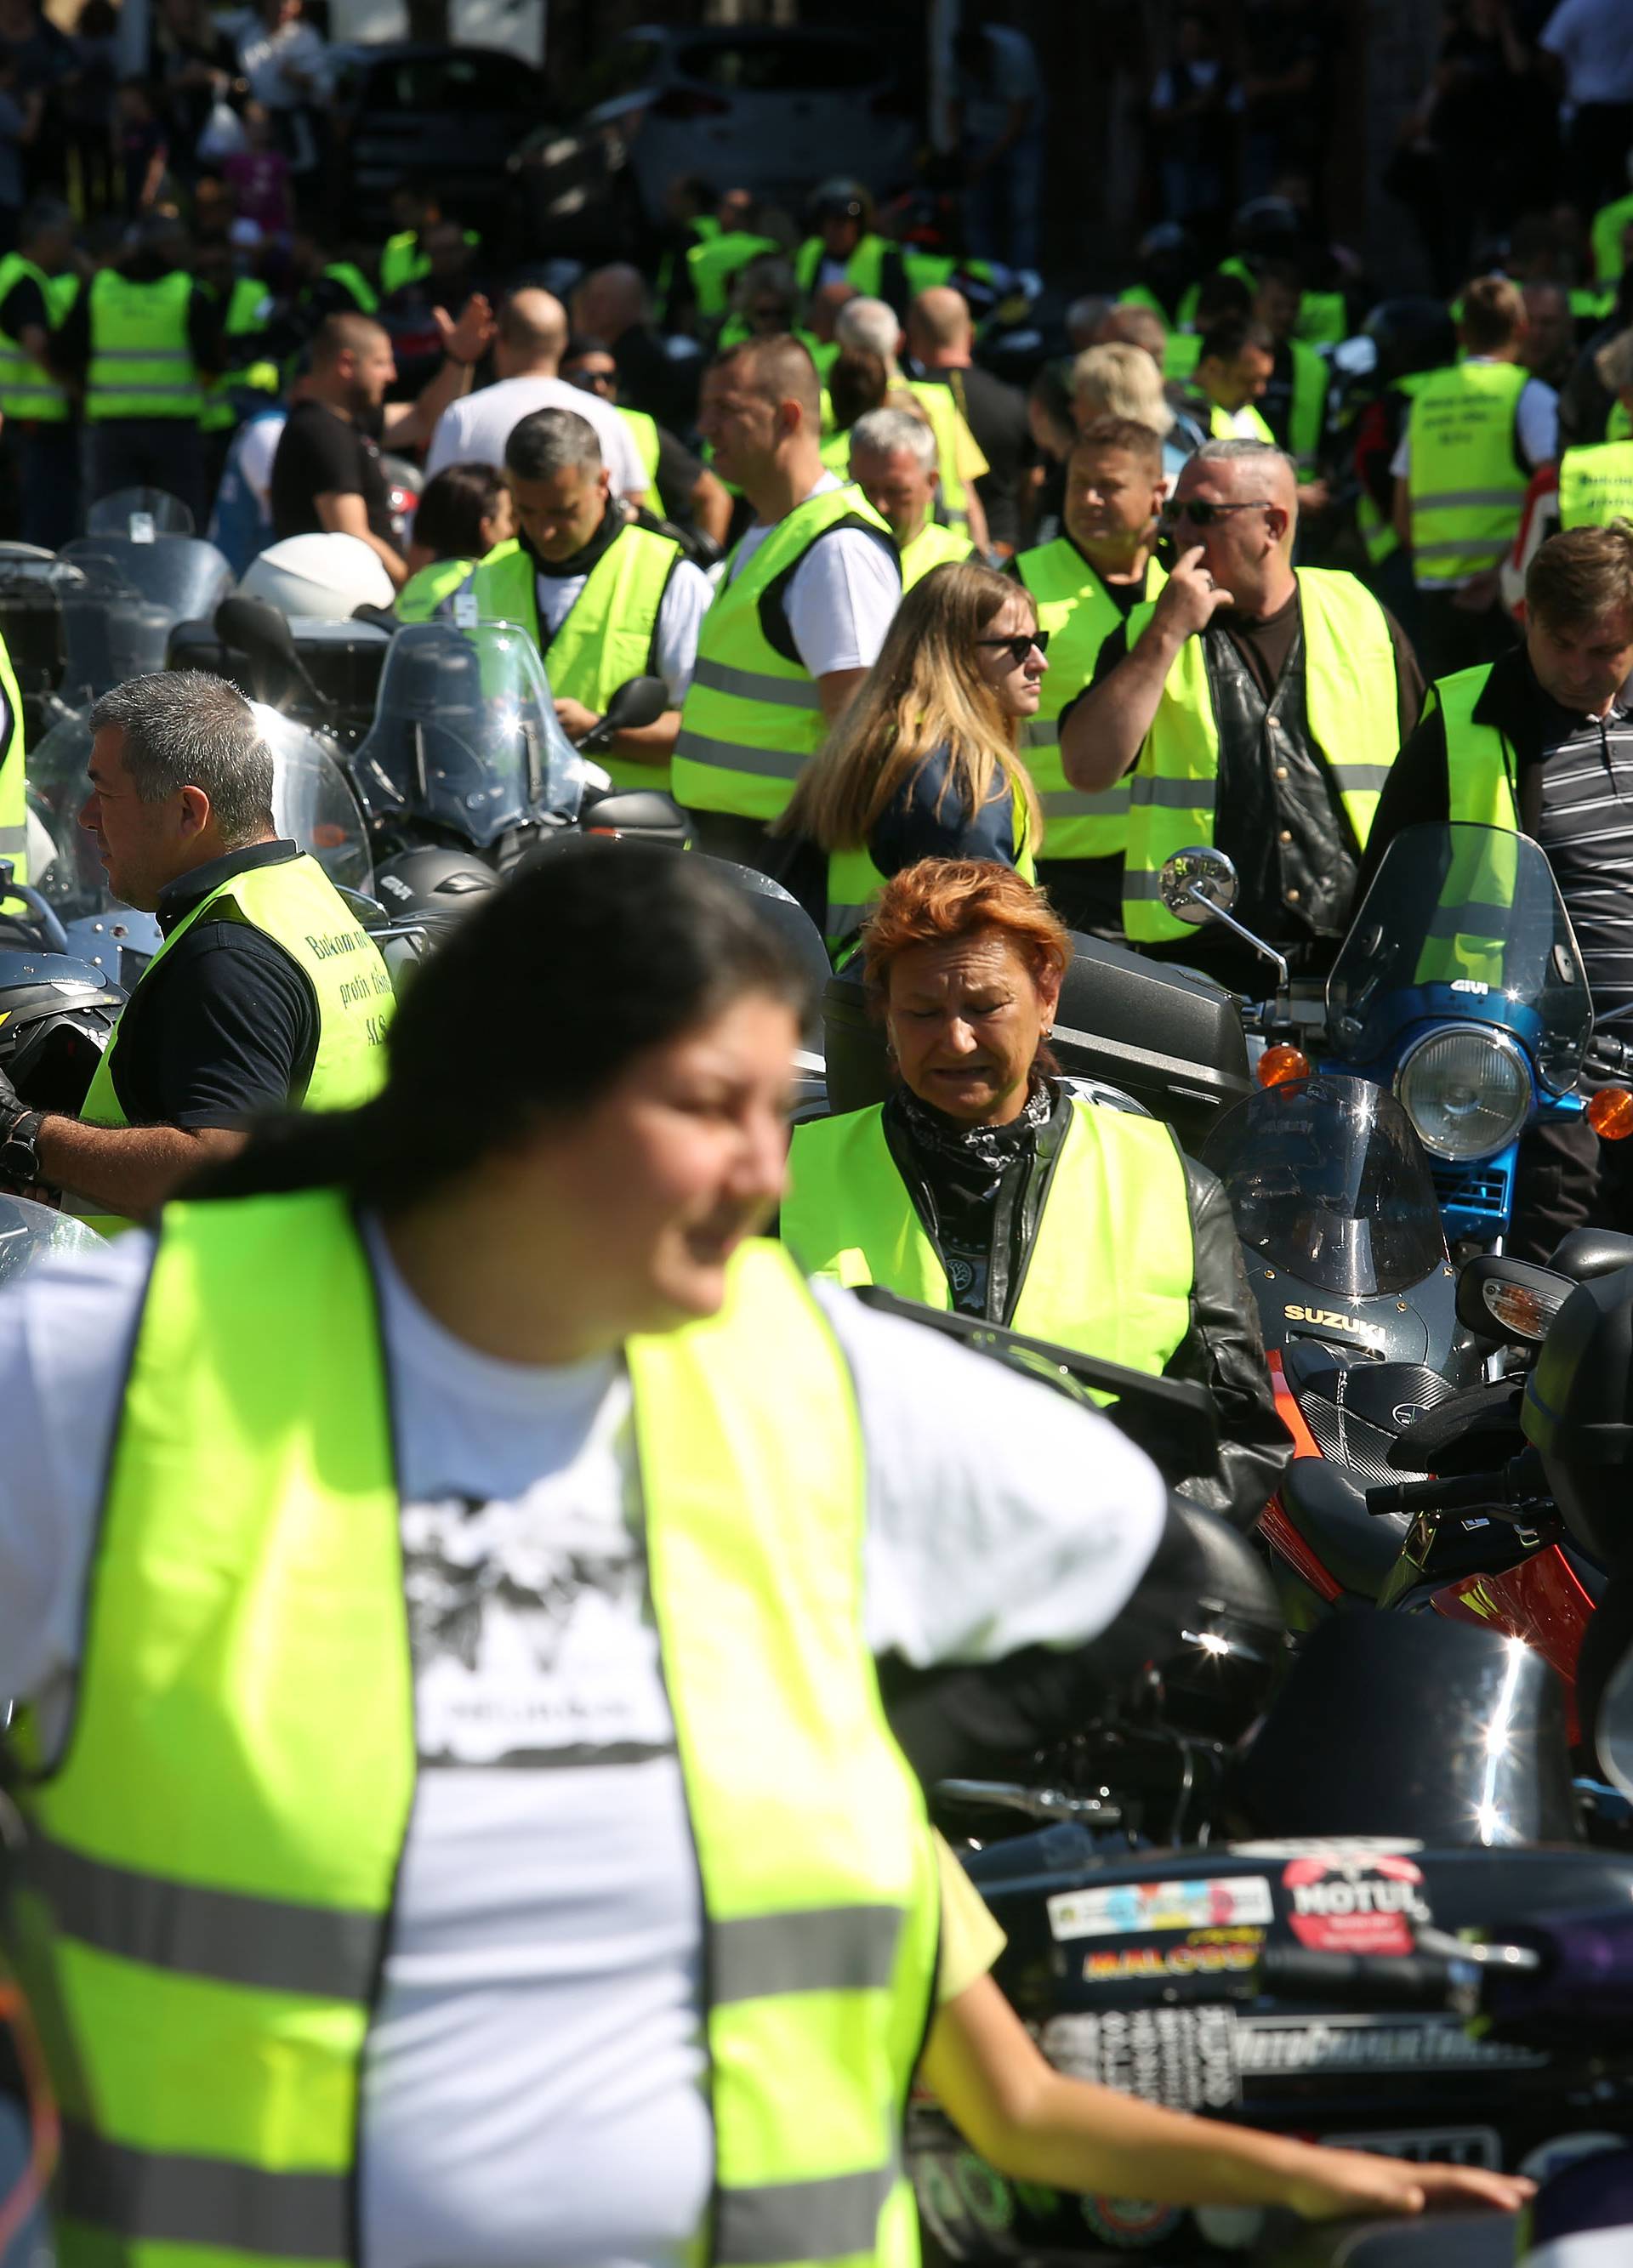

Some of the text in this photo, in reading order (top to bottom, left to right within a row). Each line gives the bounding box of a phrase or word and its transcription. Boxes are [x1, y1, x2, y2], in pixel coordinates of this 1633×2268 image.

[304, 932, 356, 960] Bukom
[339, 973, 371, 1010] protiv
[1450, 979, 1488, 995] GIVI
[1284, 1305, 1386, 1342] SUZUKI
[1293, 1879, 1420, 1917] MOTUL
